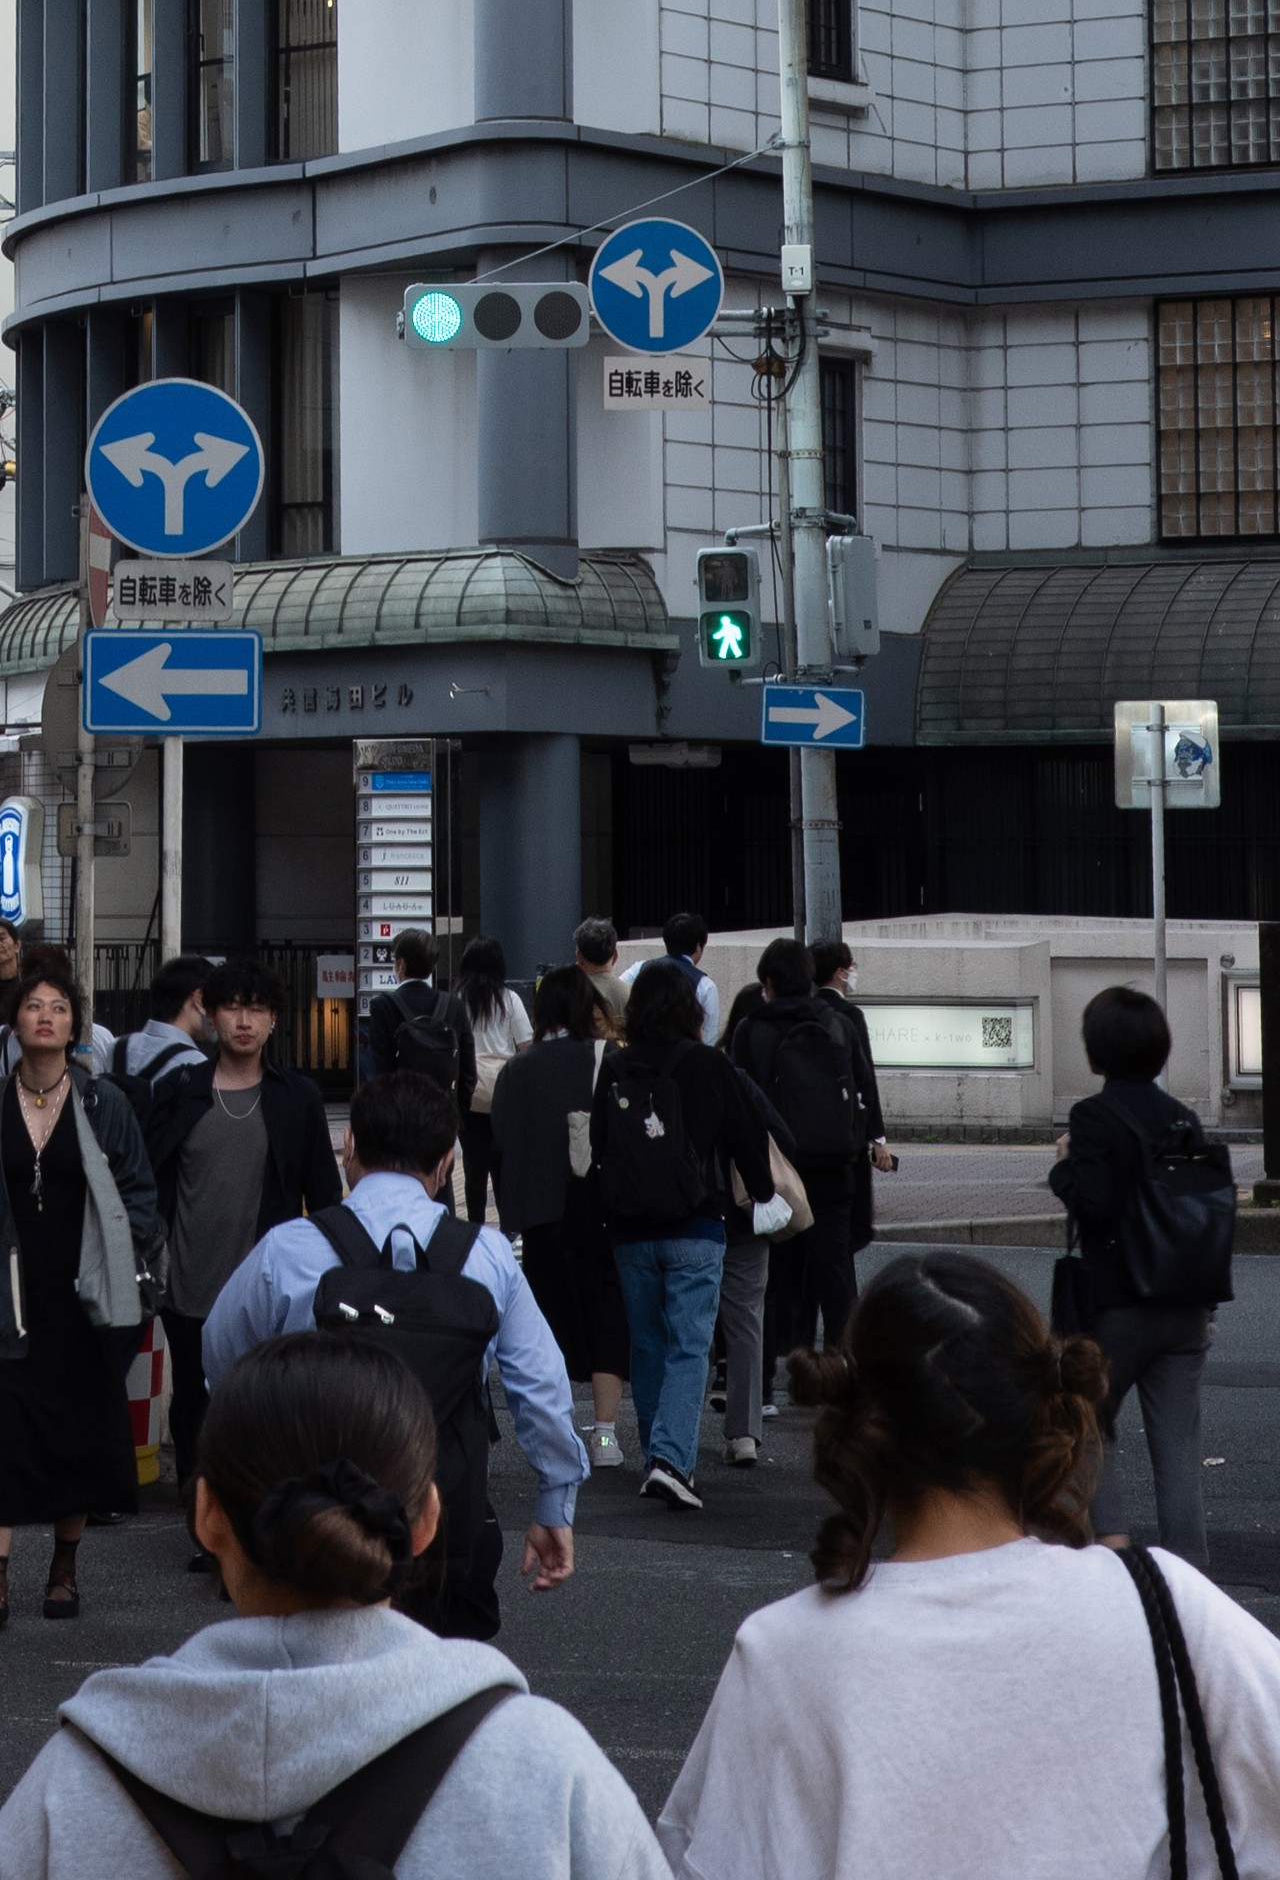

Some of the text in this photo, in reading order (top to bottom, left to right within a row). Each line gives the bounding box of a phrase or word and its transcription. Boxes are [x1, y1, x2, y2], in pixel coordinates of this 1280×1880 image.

[609, 369, 704, 398] 自転車を除く
[120, 575, 226, 607] 自転車を除く
[362, 777, 369, 786] 9
[362, 801, 369, 811] 8
[363, 826, 369, 835] 7
[362, 851, 369, 860] 6
[363, 875, 369, 885] 5
[362, 900, 369, 909] 4
[363, 924, 369, 934] 3
[363, 949, 369, 959] 2
